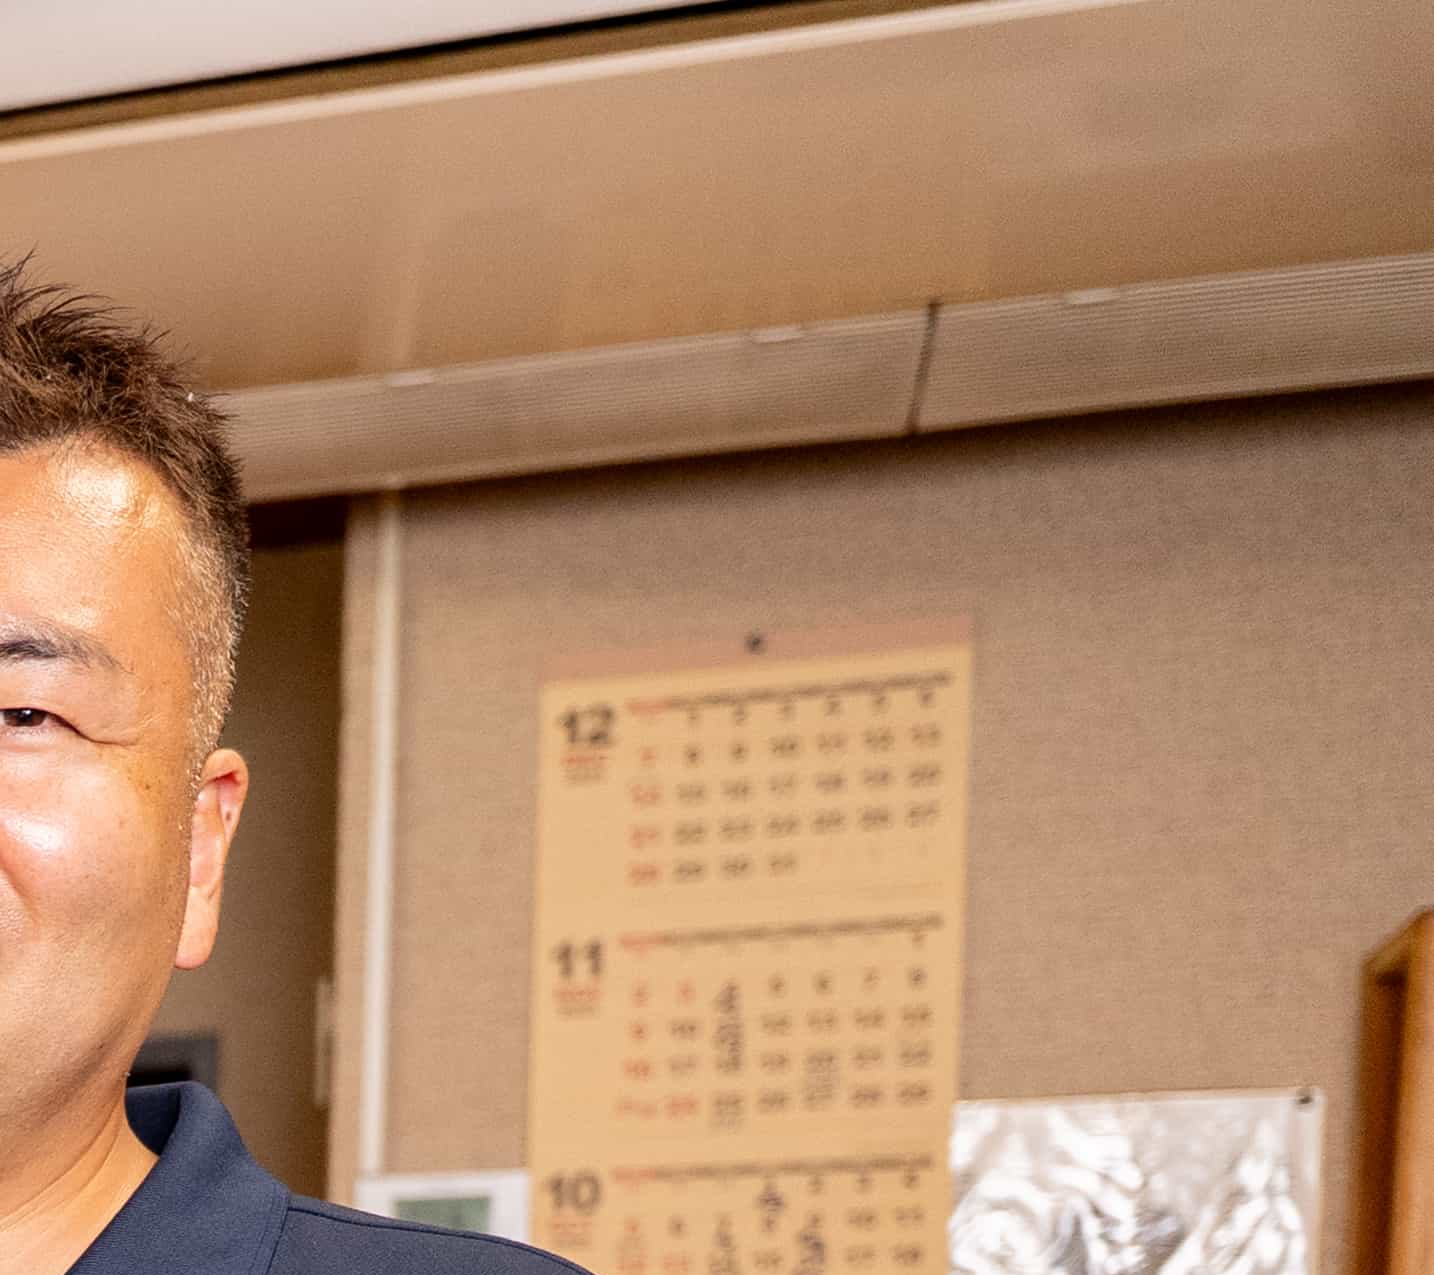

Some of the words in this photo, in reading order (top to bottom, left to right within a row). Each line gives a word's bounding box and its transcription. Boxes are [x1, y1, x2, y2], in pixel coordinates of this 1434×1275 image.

[561, 704, 614, 747] 12
[556, 940, 604, 978] 11
[548, 1172, 600, 1211] 10
